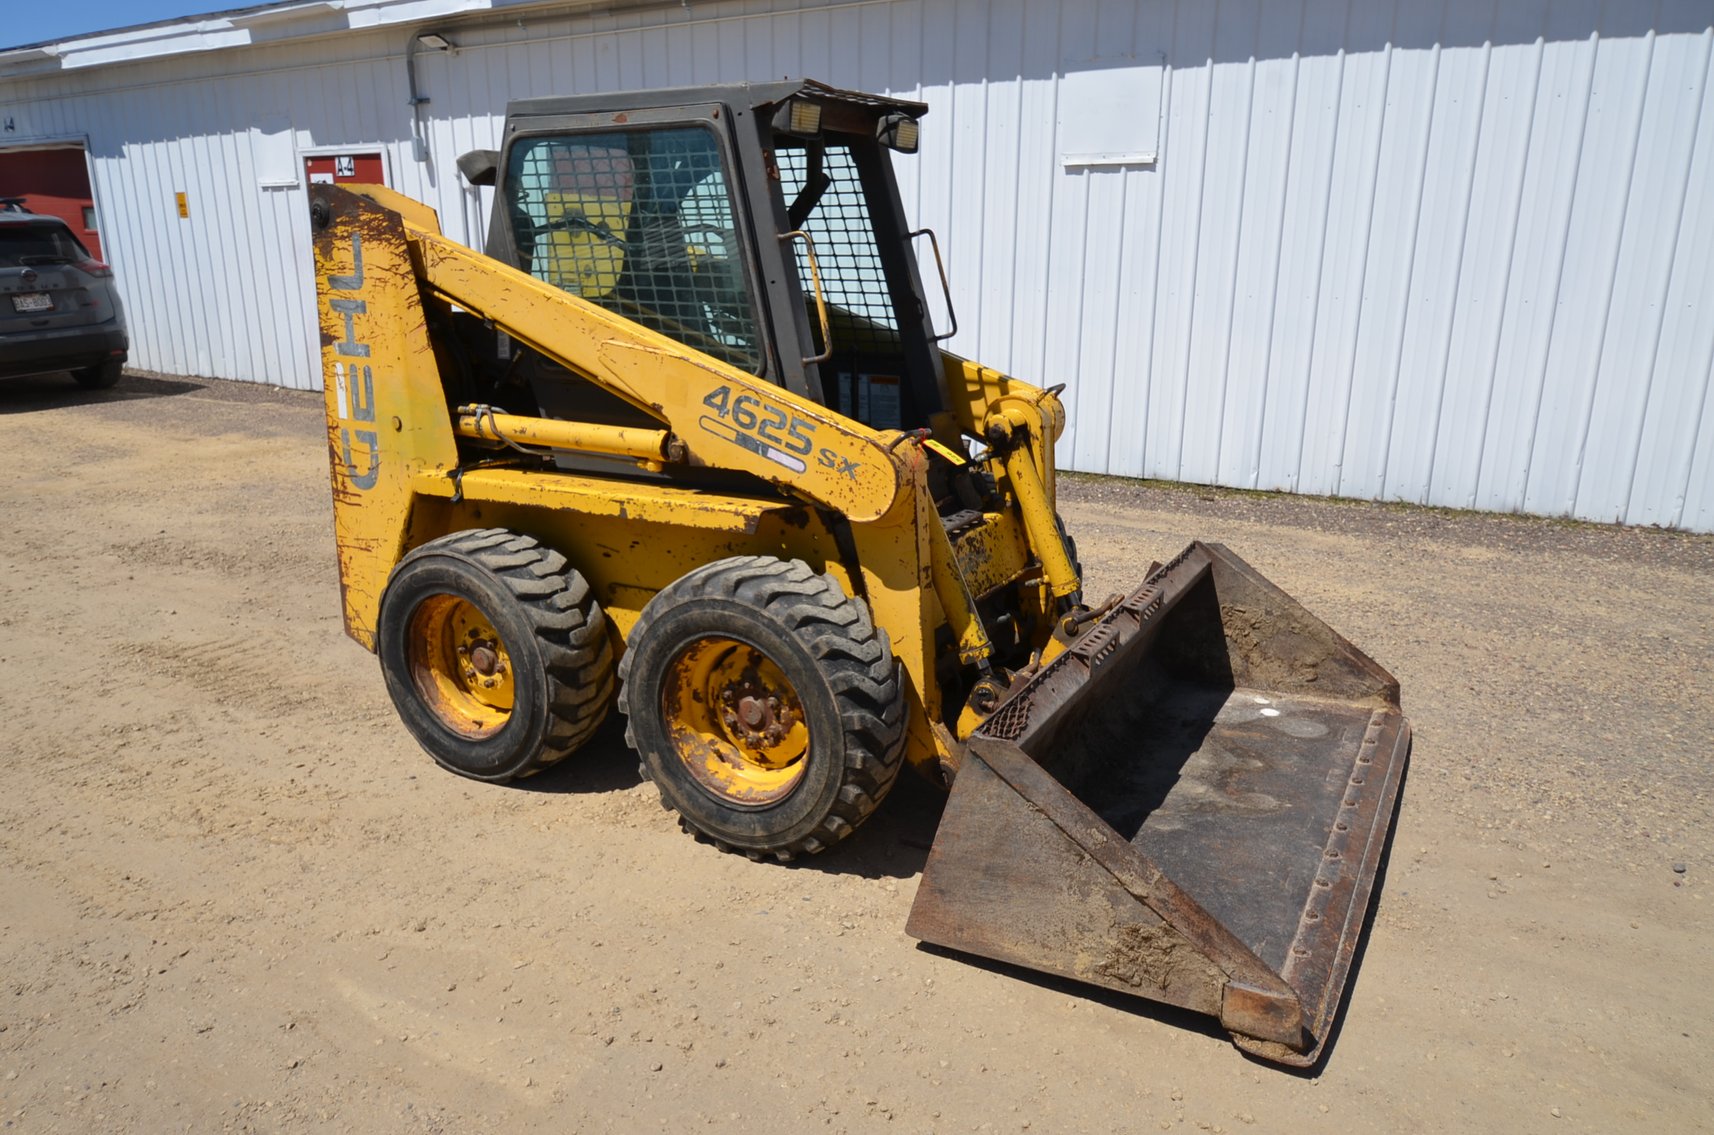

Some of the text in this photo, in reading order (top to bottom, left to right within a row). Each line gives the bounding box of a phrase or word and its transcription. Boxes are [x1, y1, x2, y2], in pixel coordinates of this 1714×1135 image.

[326, 231, 379, 491] GEHL
[703, 385, 816, 455] 4625
[817, 448, 861, 480] SX
